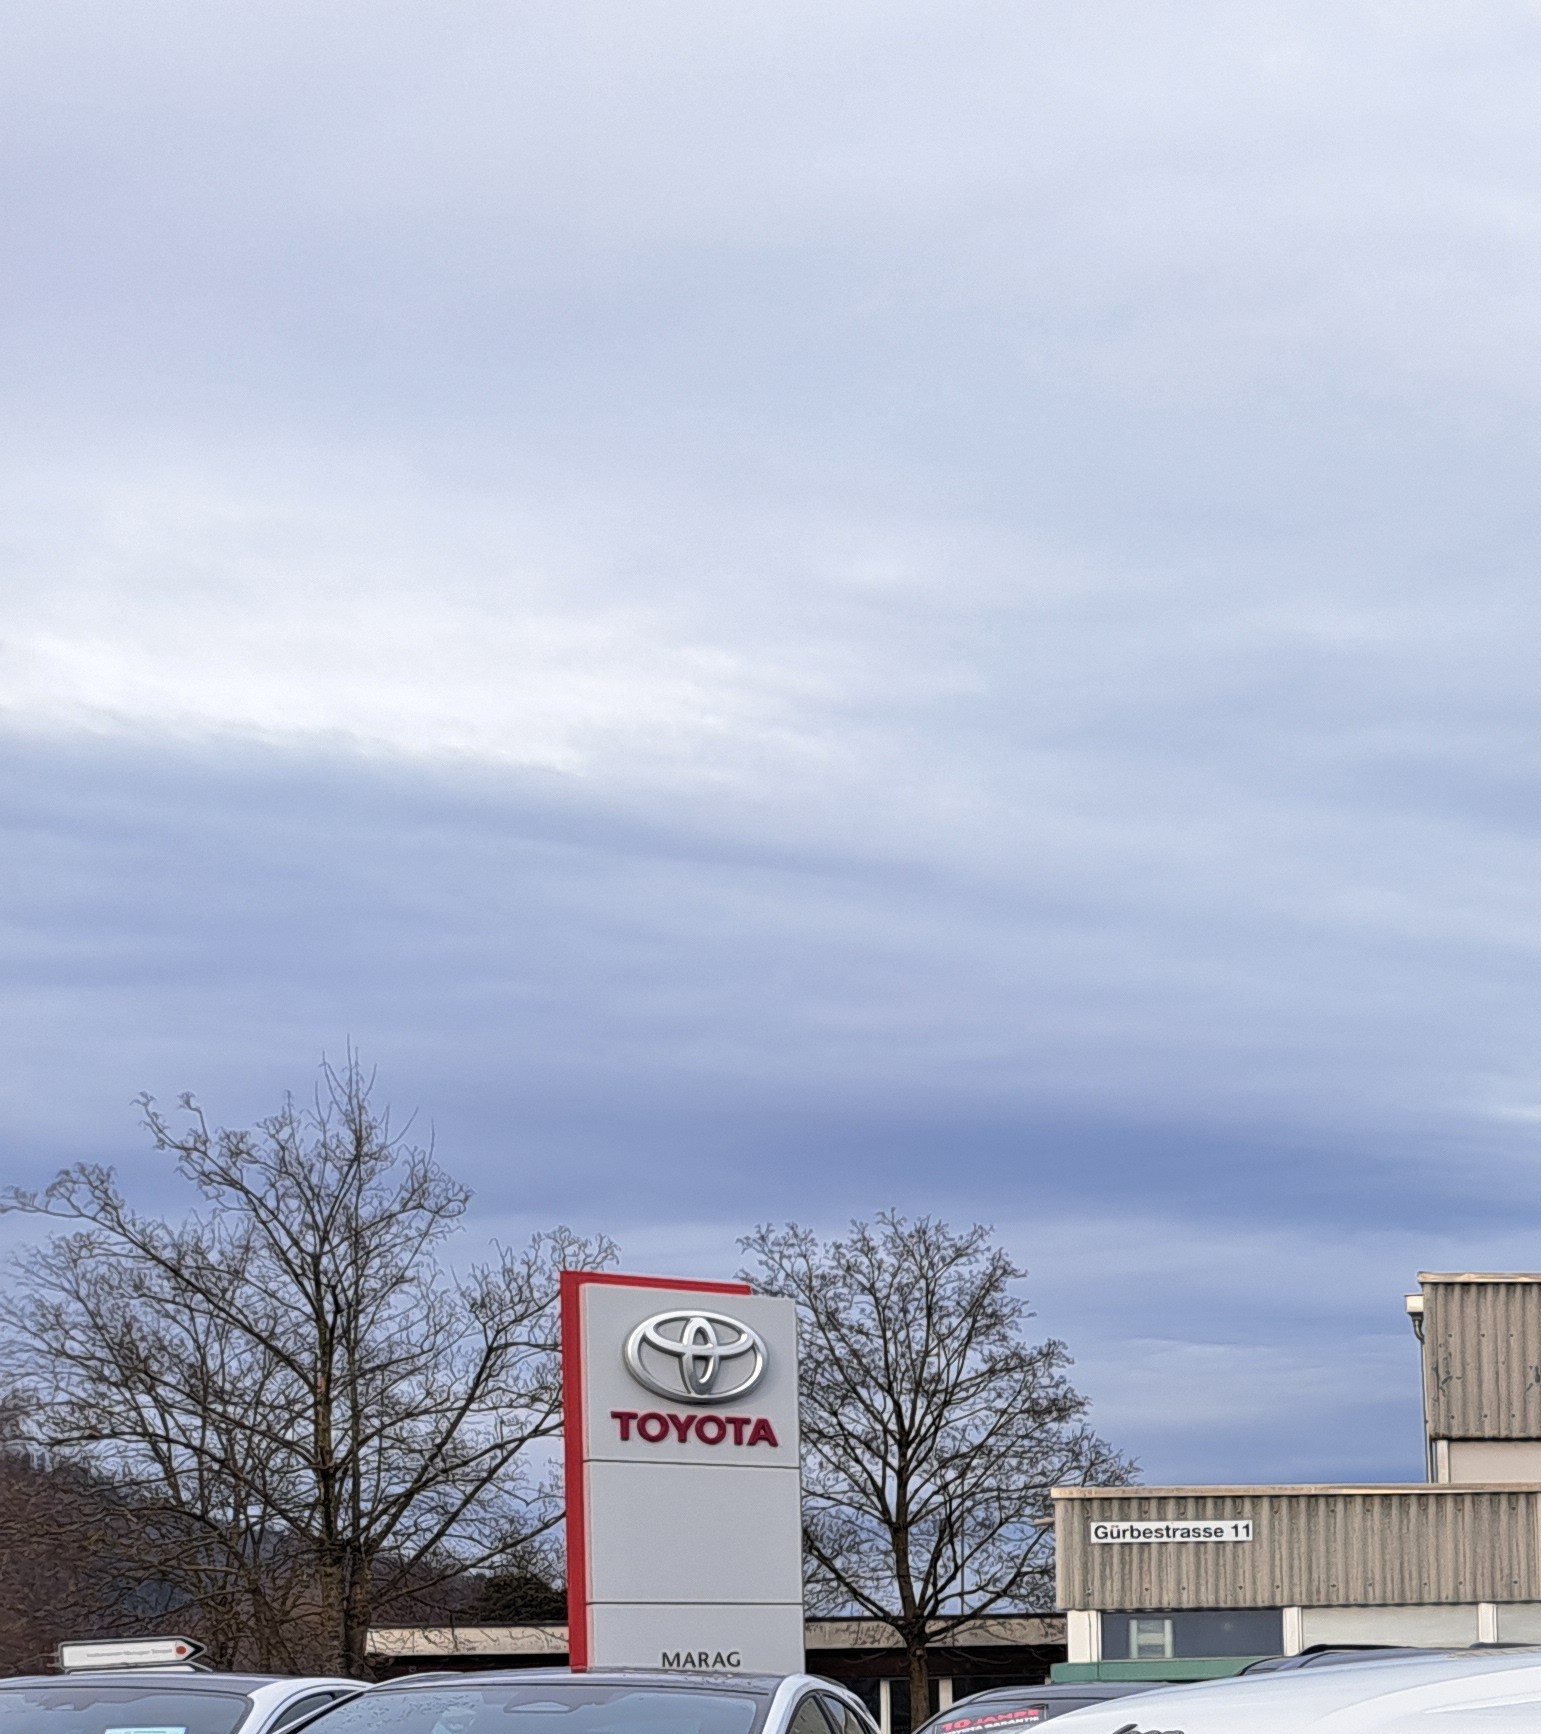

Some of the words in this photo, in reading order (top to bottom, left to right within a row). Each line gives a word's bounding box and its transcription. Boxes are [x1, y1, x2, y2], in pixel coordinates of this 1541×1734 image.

[610, 1410, 779, 1447] TOYOTA
[1094, 1524, 1225, 1540] Gürbestrasse
[1230, 1523, 1250, 1538] 11
[662, 1651, 741, 1668] MARAG
[942, 1718, 972, 1733] 10
